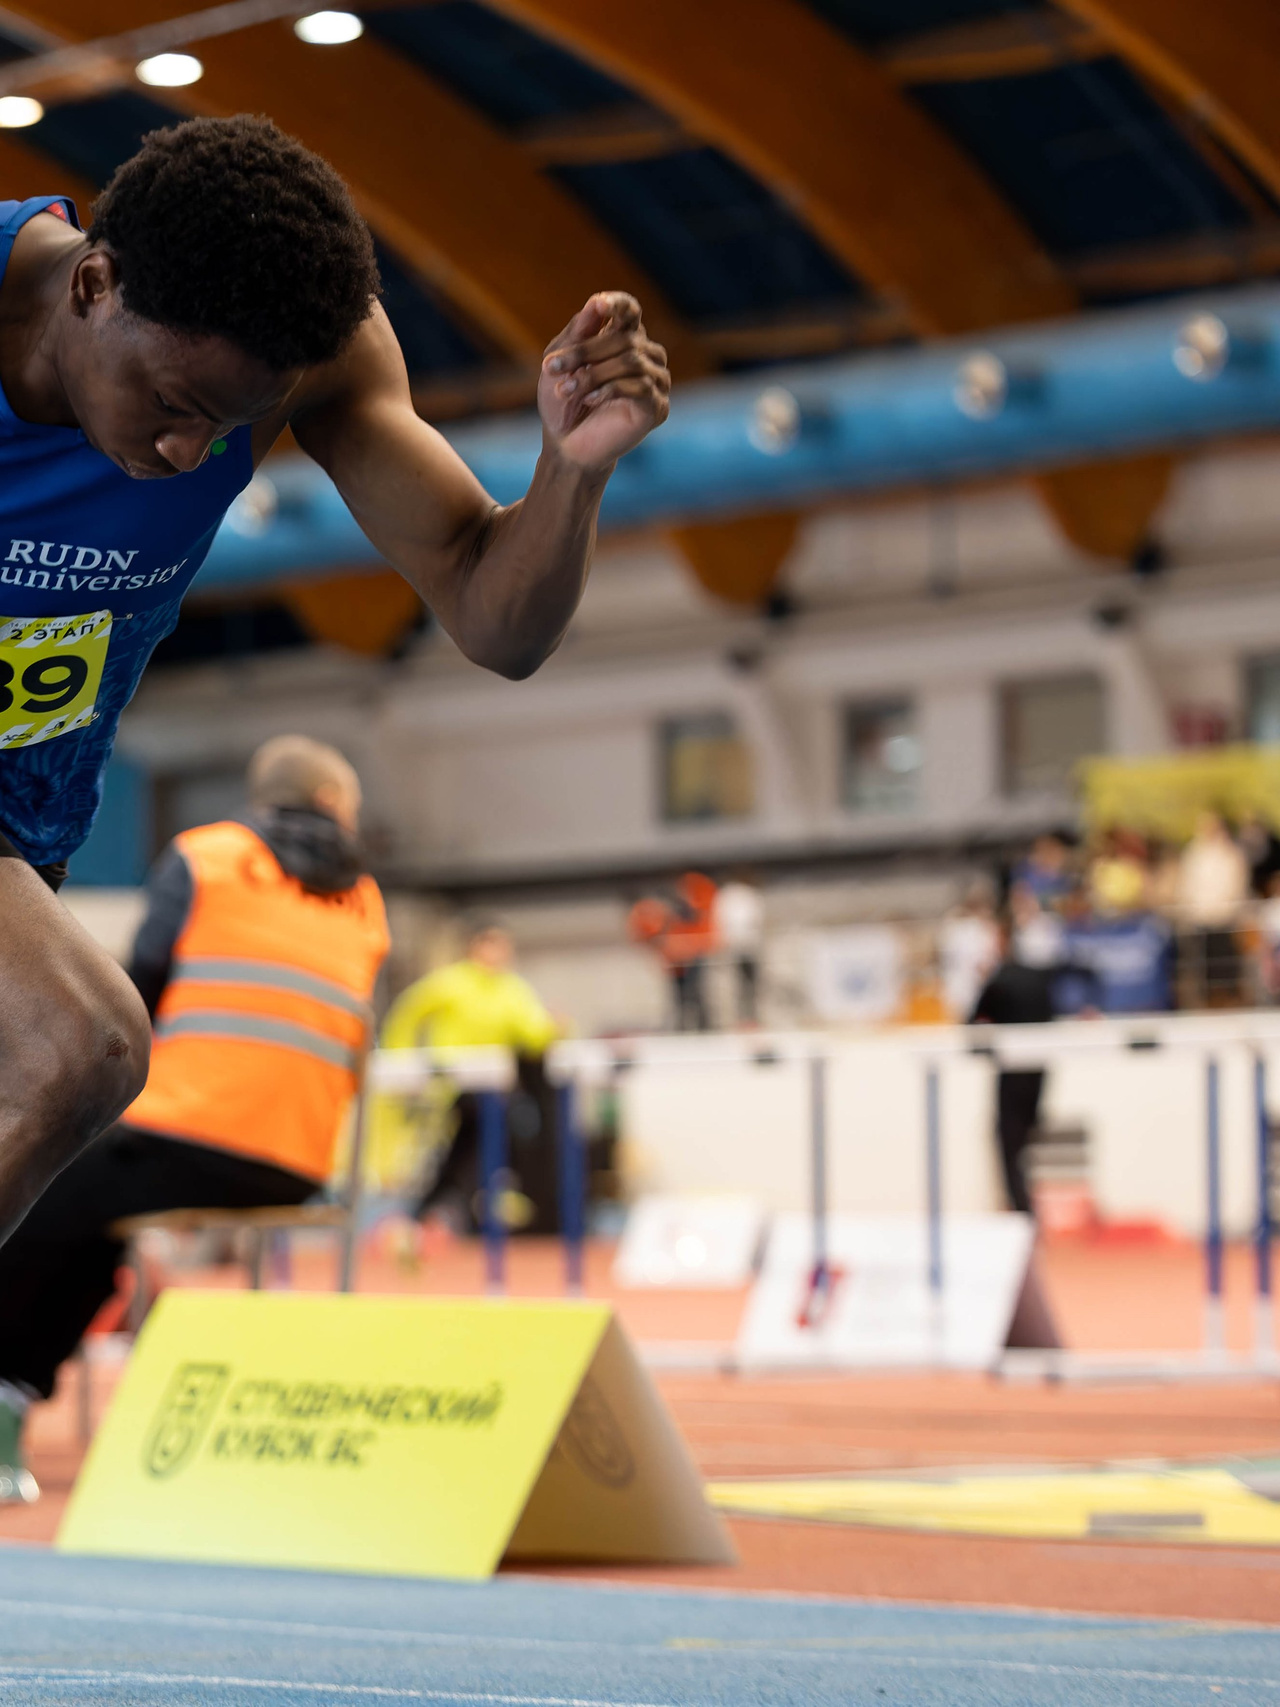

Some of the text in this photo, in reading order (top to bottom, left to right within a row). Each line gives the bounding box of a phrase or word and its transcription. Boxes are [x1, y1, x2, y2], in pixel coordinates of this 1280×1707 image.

[4, 539, 140, 573] RUDN
[0, 557, 187, 592] university
[10, 623, 95, 640] 2 ЭТАП
